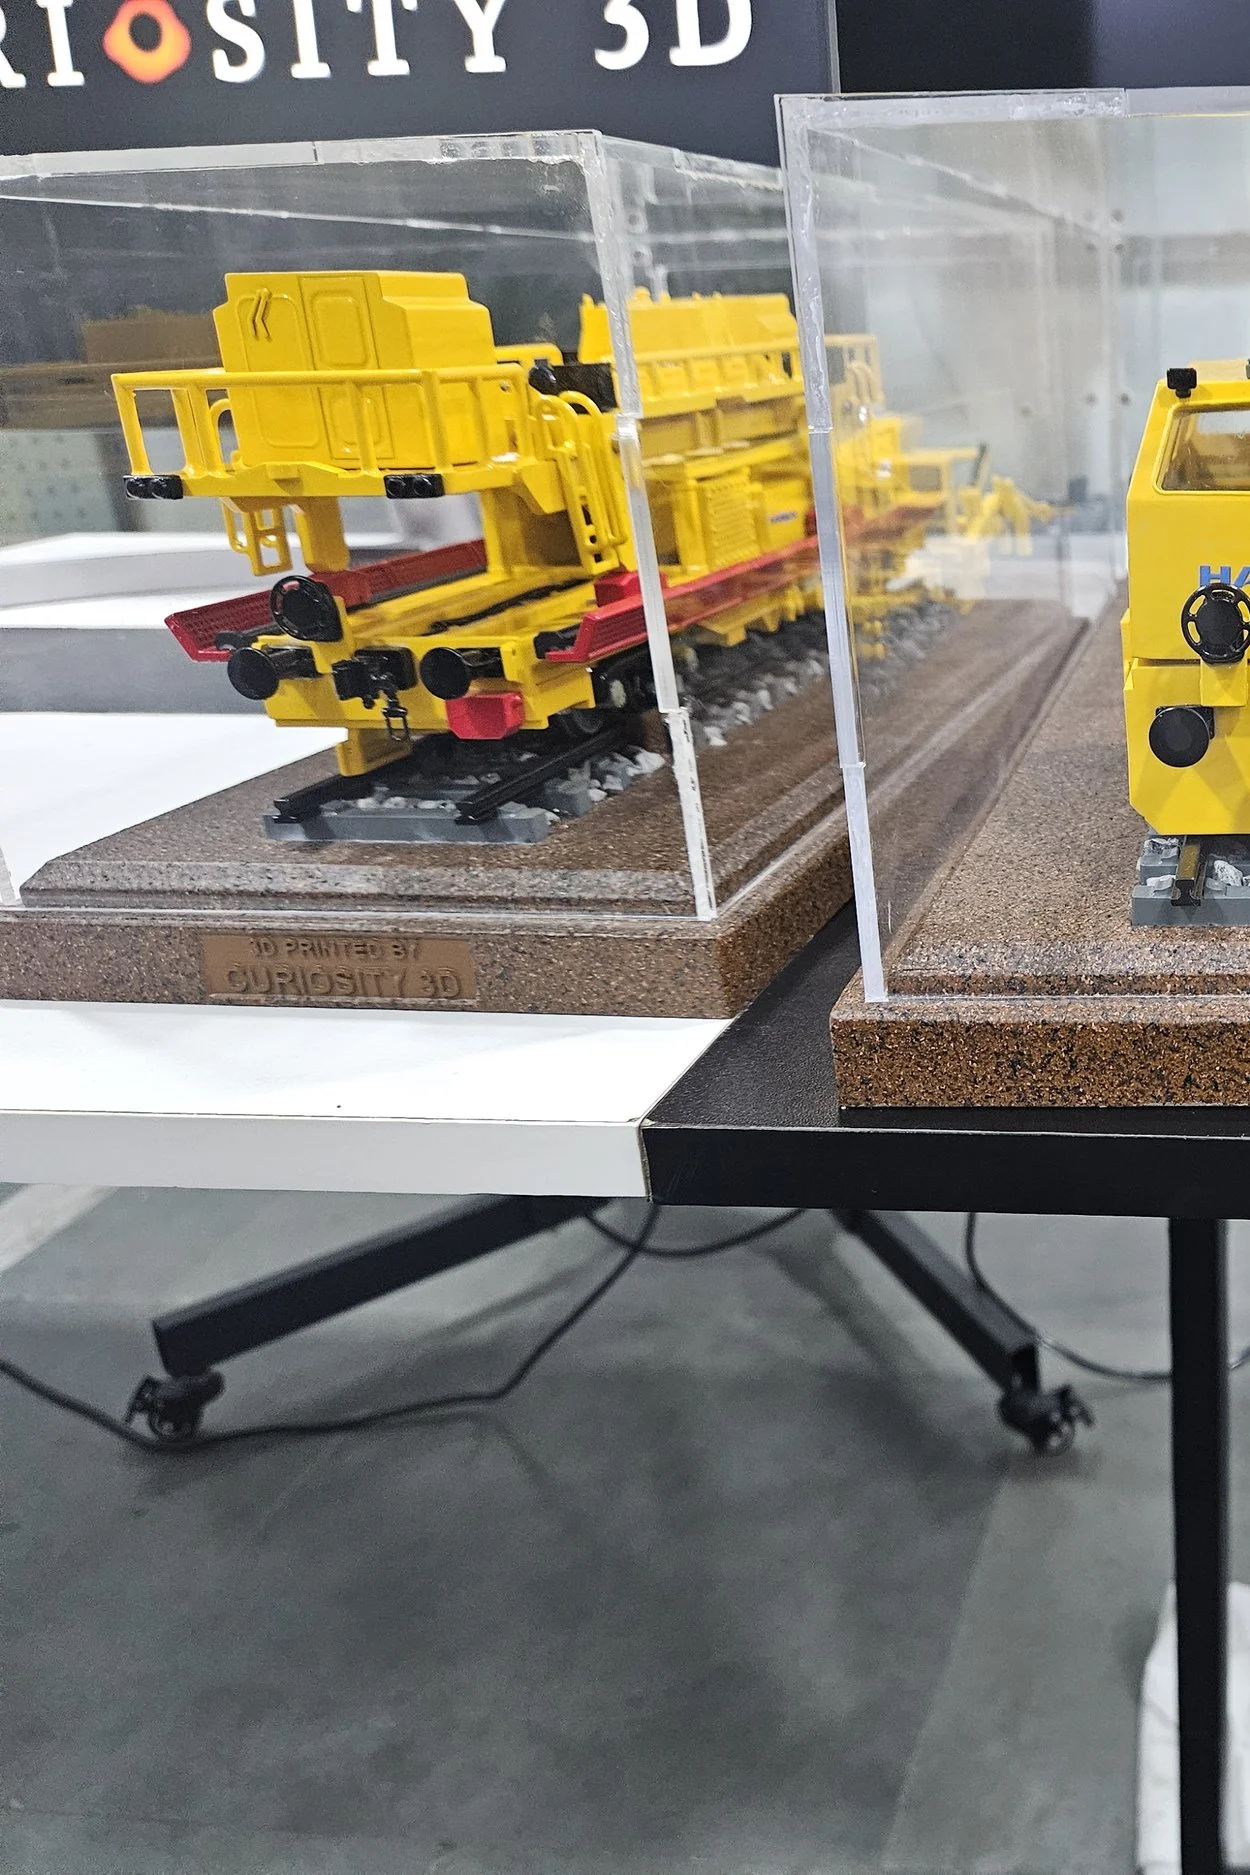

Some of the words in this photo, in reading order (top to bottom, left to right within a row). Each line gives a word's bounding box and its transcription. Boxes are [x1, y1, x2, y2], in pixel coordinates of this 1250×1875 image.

[594, 0, 753, 71] 3D
[285, 937, 385, 960] PRINTED
[392, 939, 421, 961] BY
[418, 967, 463, 998] 3D
